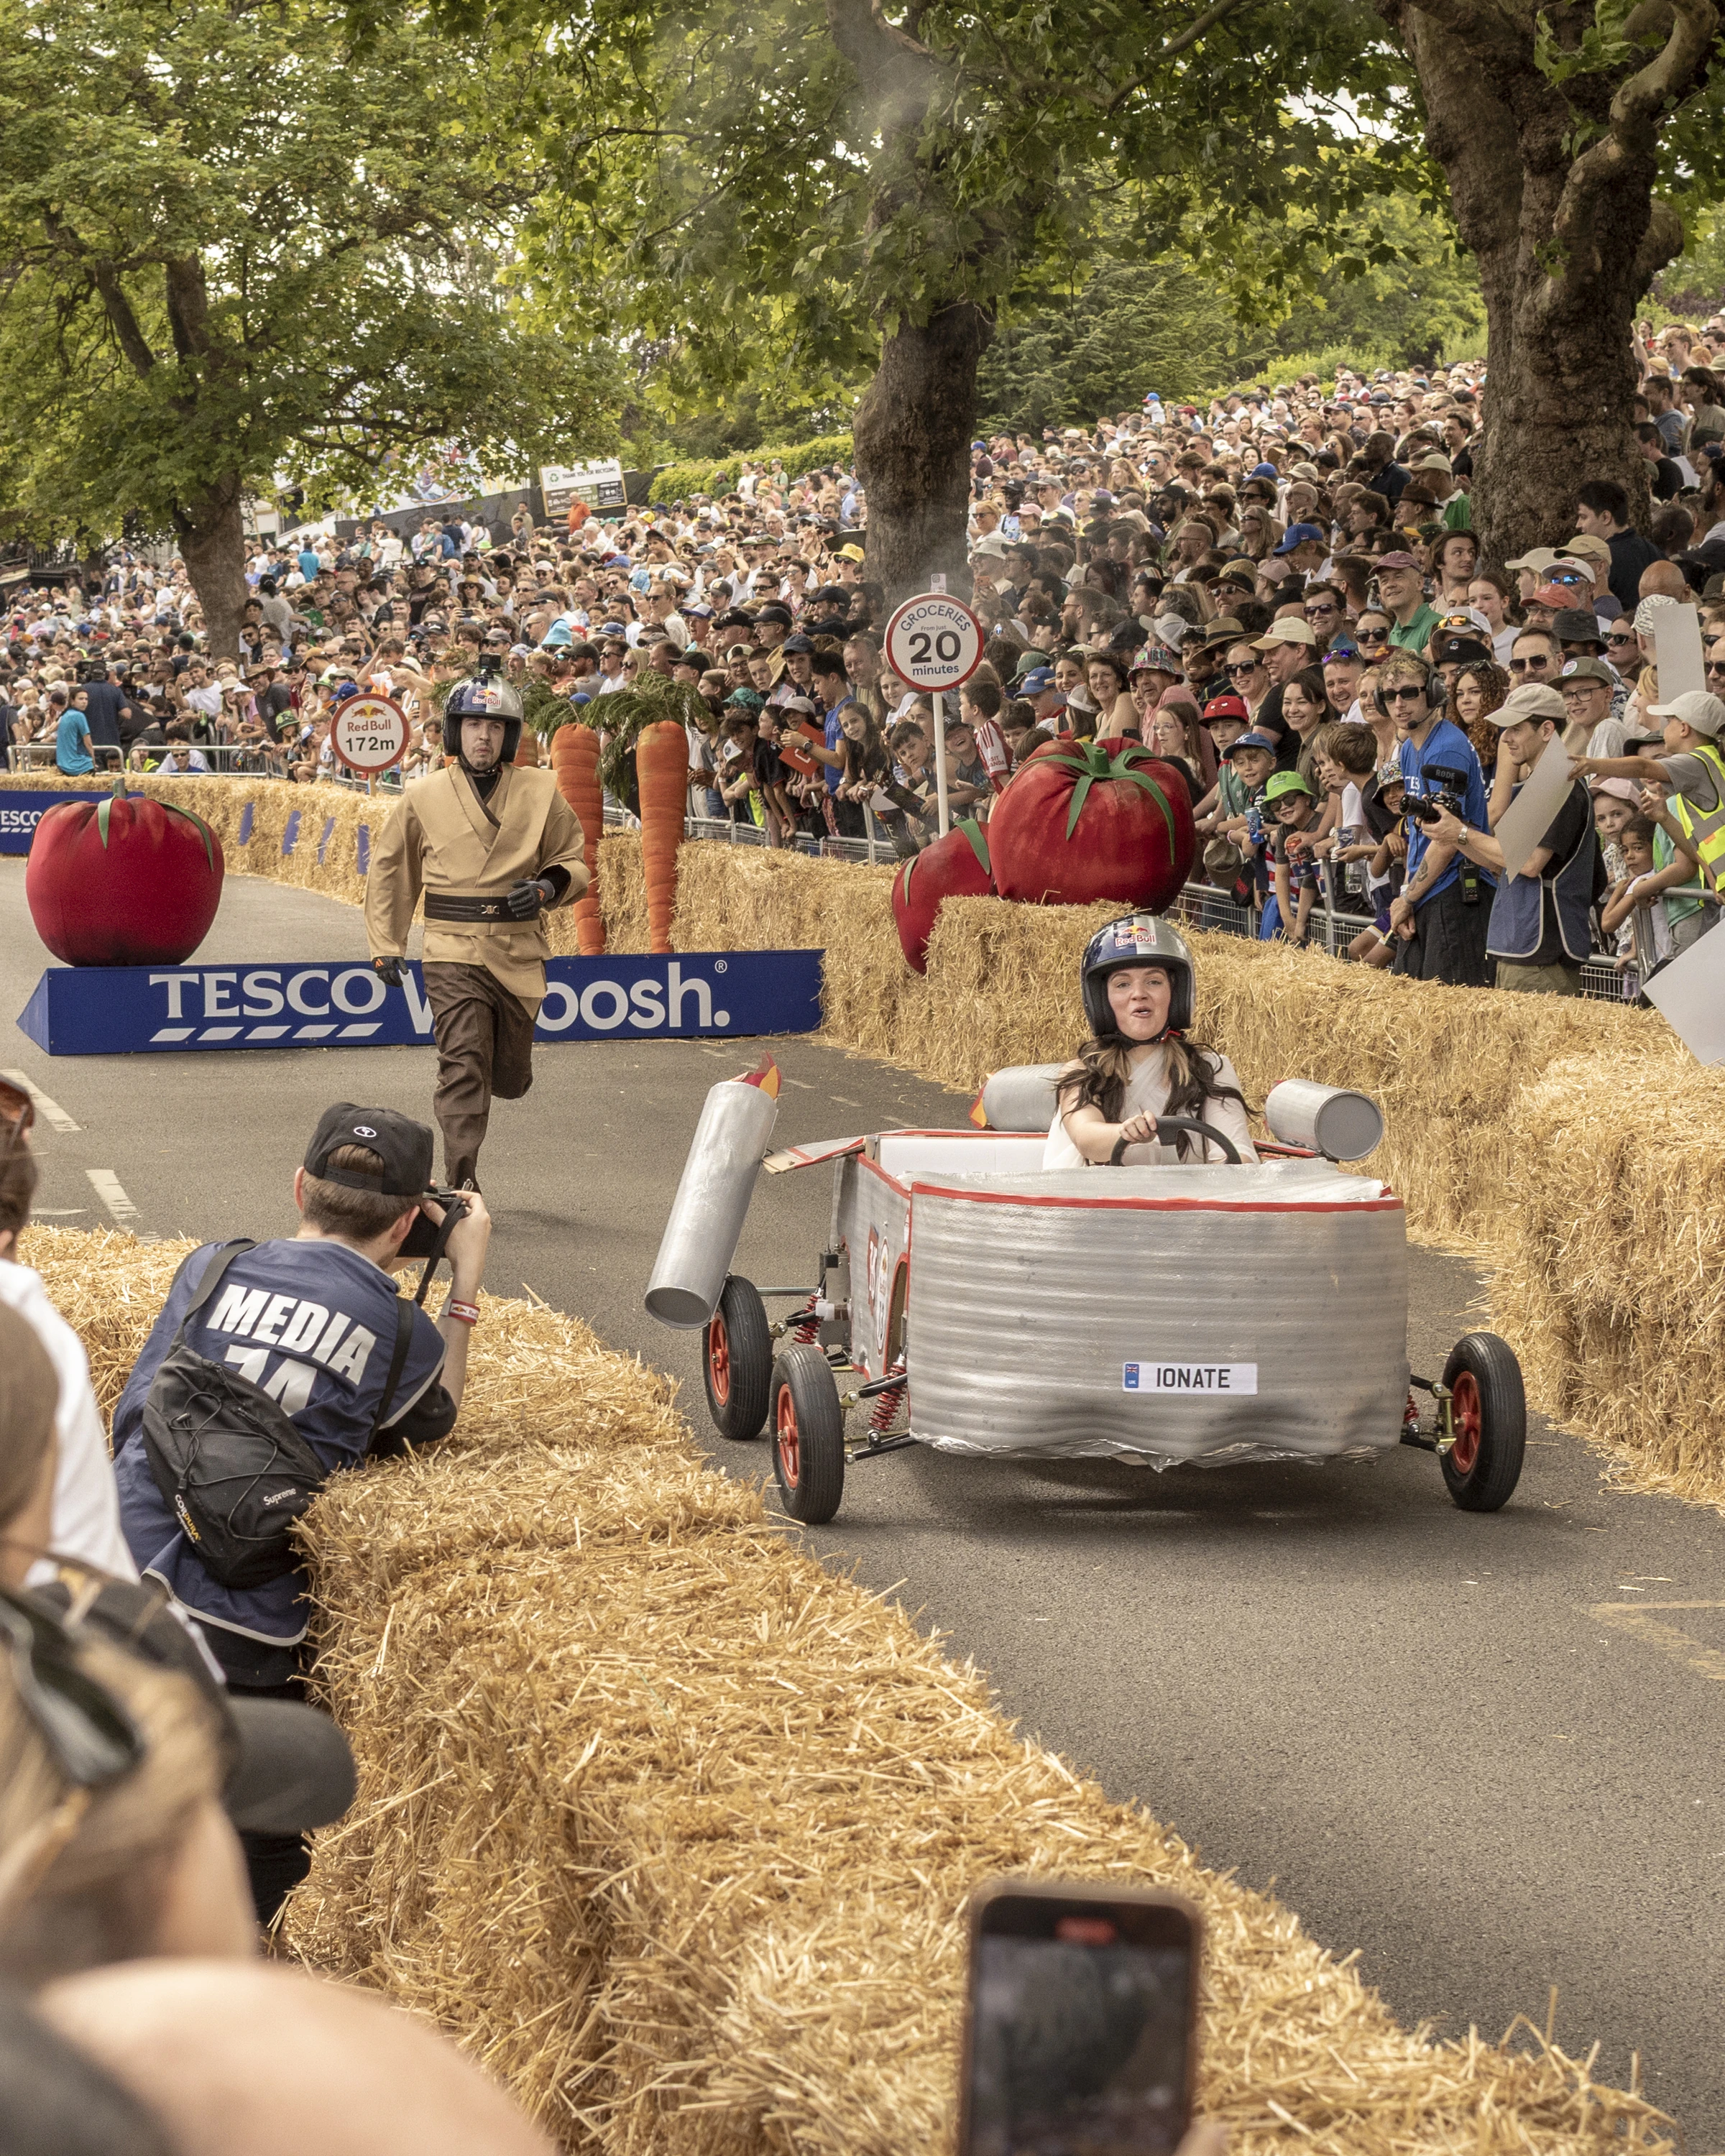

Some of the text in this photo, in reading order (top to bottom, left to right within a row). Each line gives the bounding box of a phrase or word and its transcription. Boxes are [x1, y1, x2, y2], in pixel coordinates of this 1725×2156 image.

[901, 604, 971, 631] GROCERIES
[908, 630, 961, 664] 20
[912, 664, 960, 676] minutes
[472, 696, 501, 706] Red Bull
[347, 719, 391, 732] Red Bull
[346, 736, 395, 752] 172m
[0, 810, 42, 826] ESCO
[1116, 934, 1155, 946] Red Bull
[149, 968, 387, 1018] TESCO
[206, 1284, 377, 1386] MEDIA
[1156, 1368, 1231, 1388] IONATE
[263, 1488, 297, 1506] Supreme
